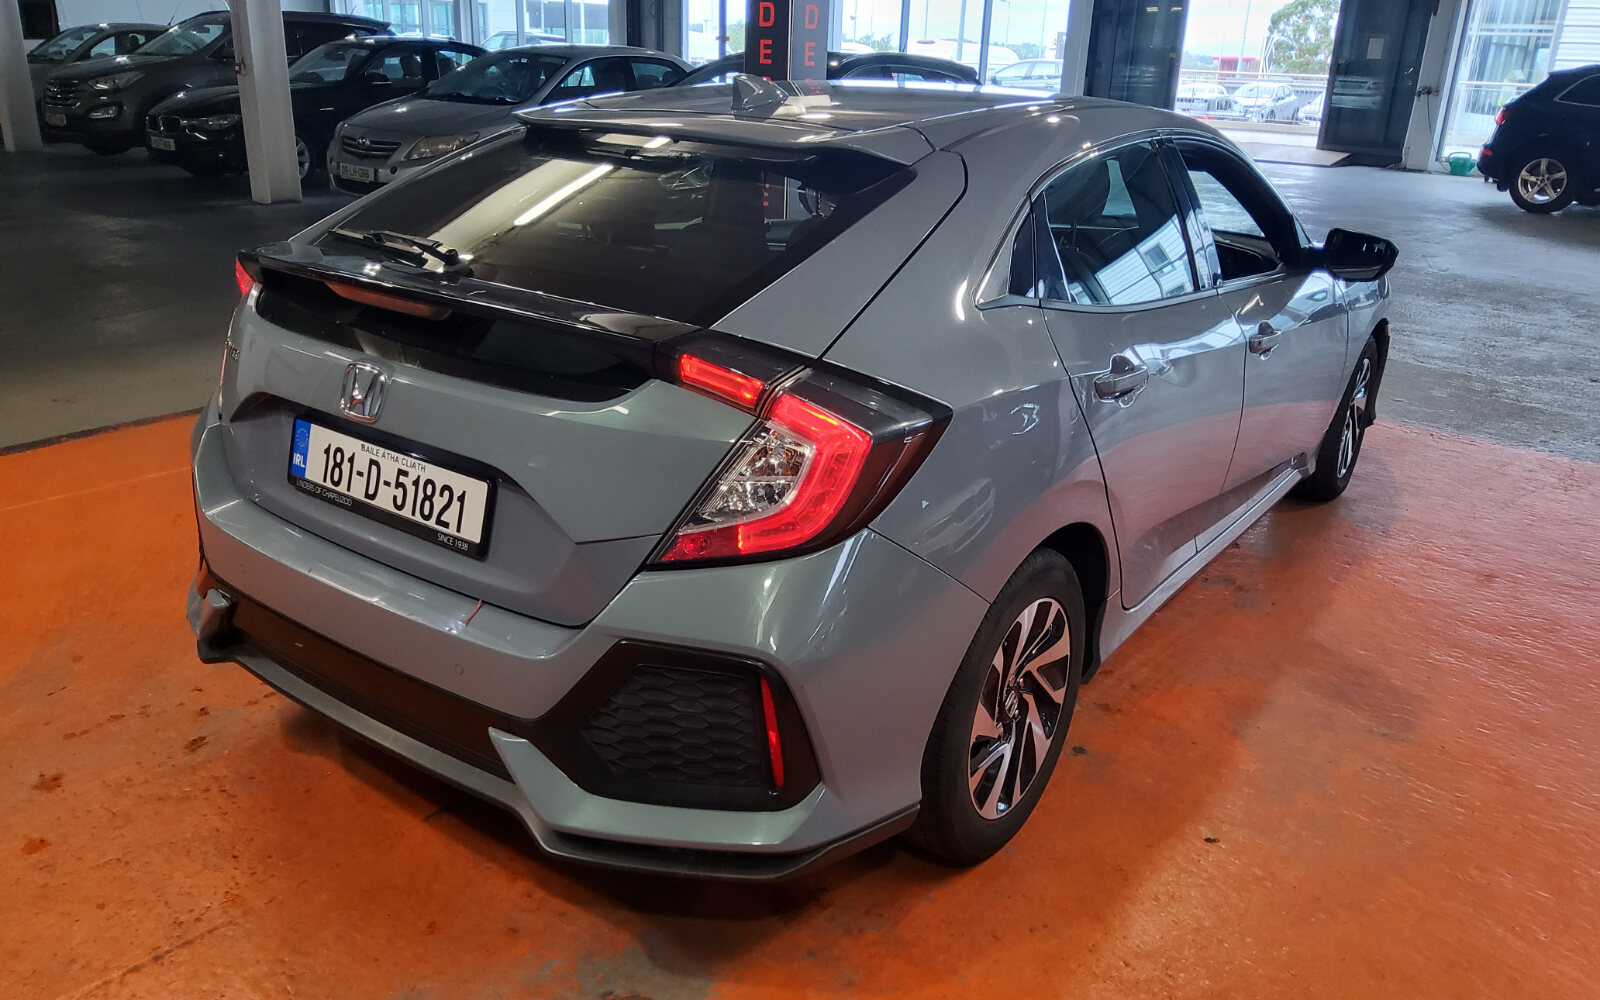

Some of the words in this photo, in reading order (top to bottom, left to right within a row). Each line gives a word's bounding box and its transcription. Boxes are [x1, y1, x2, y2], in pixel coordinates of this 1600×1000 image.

[292, 452, 305, 468] IRL
[361, 444, 381, 457] BAILE
[401, 457, 426, 472] CLIATH
[315, 486, 322, 494] OF
[323, 443, 466, 533] 181-D-51821
[437, 532, 454, 546] SINCE
[454, 539, 469, 551] 1938
